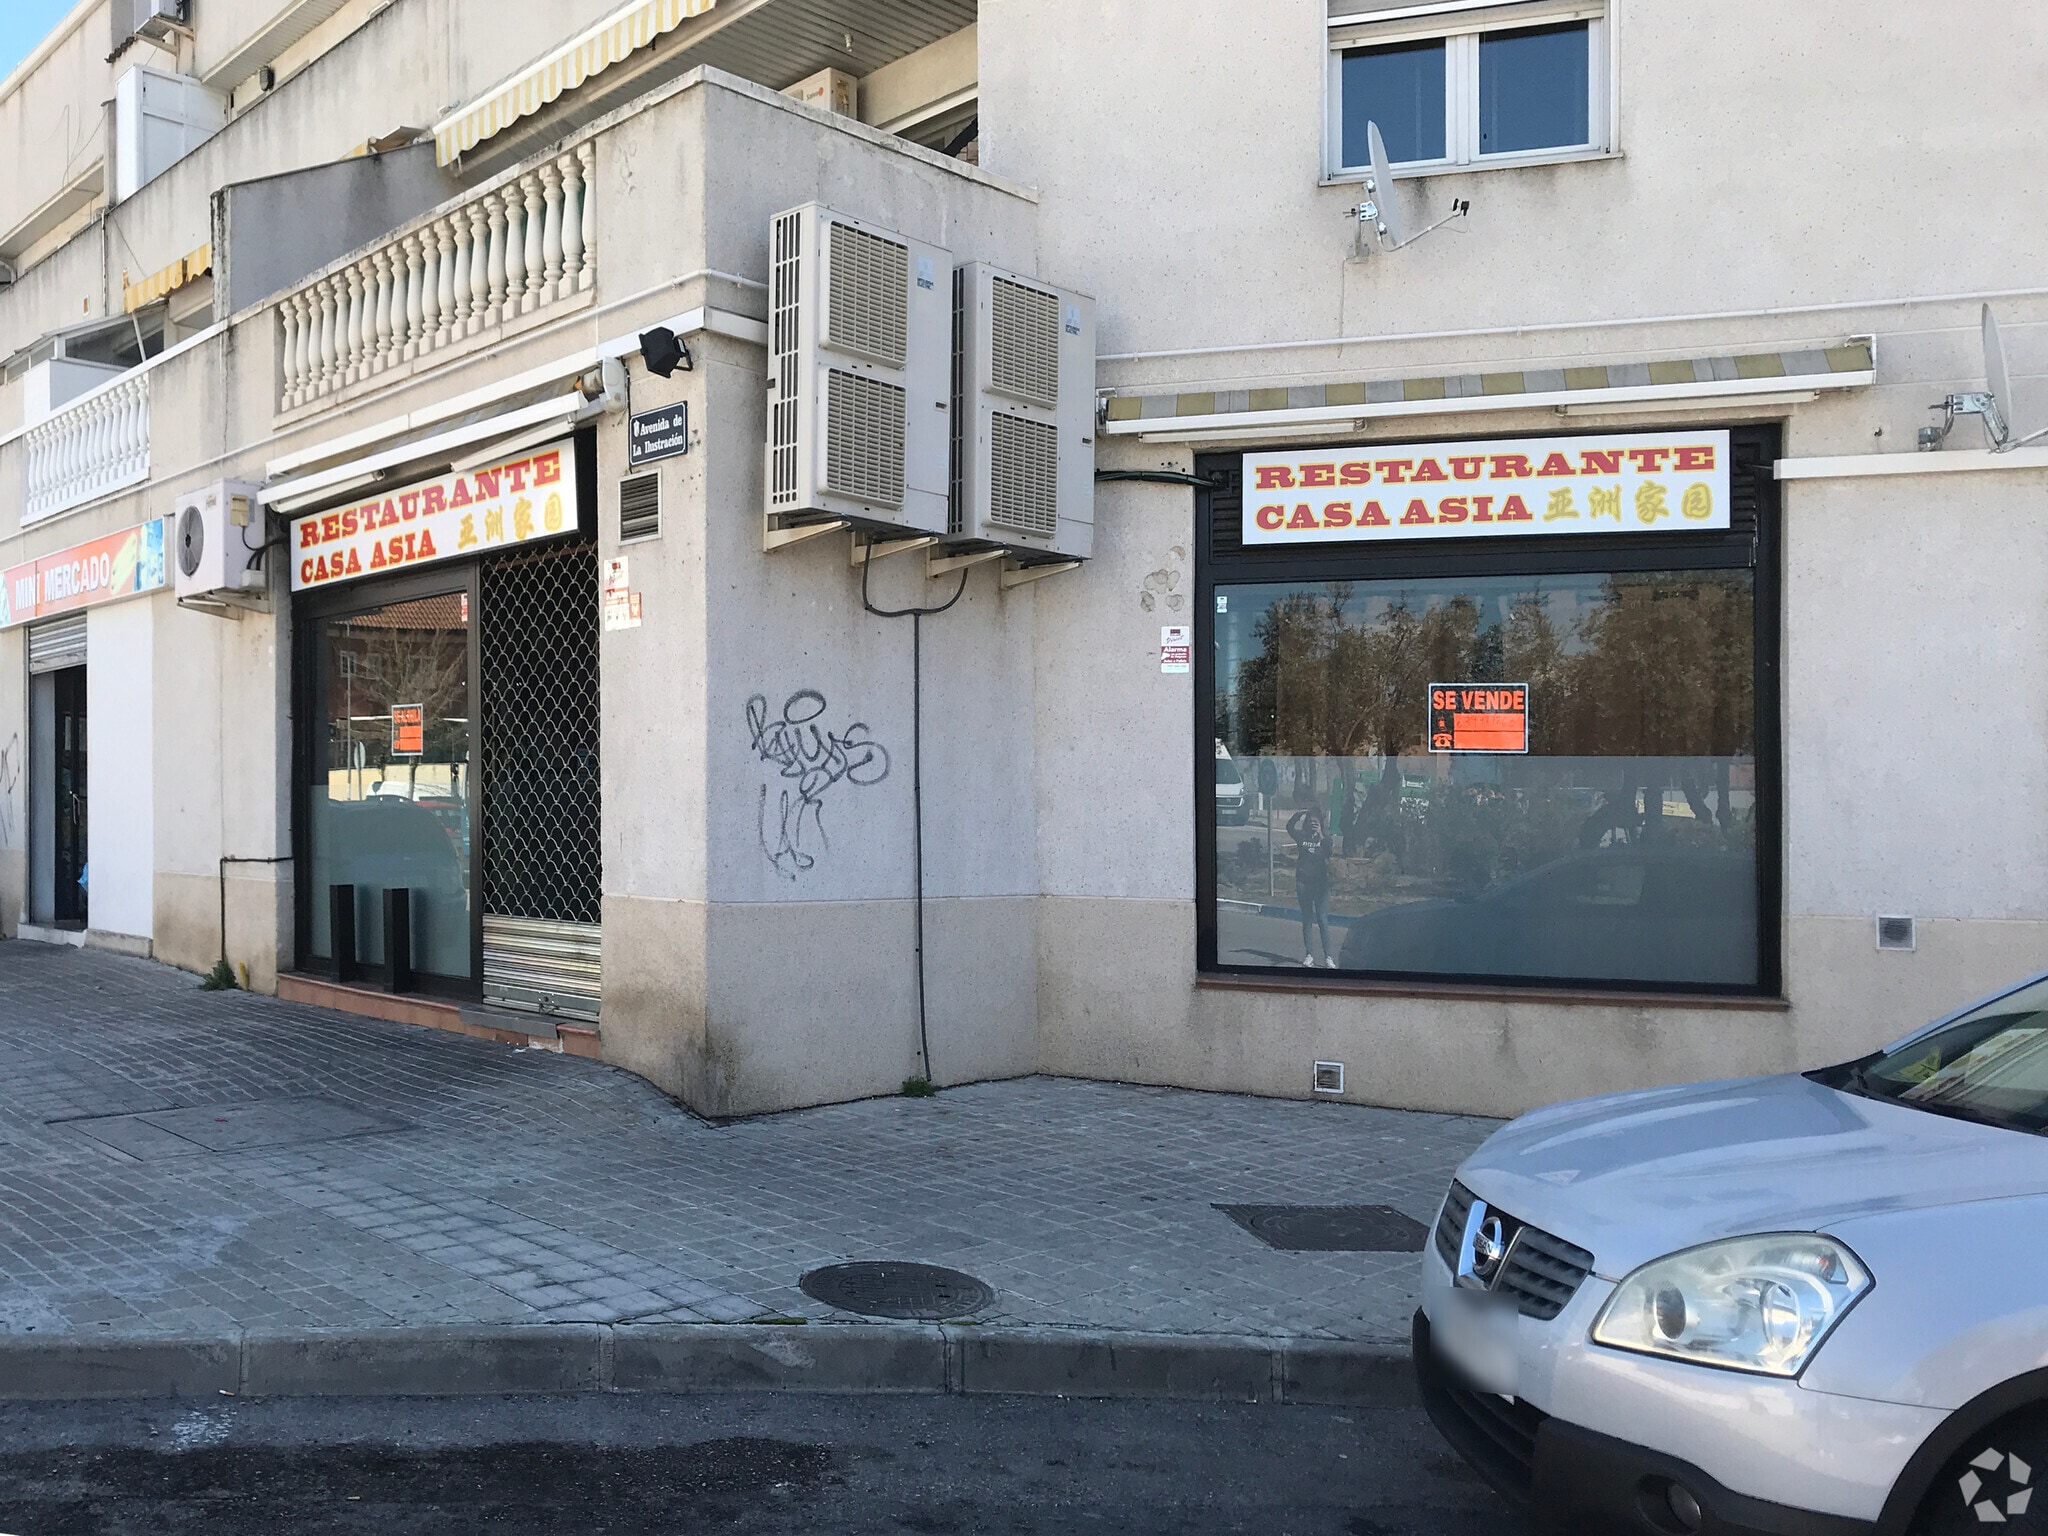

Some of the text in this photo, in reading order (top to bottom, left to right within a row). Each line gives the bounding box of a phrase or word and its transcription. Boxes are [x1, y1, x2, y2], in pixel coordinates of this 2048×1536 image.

[633, 432, 683, 457] La Ilustración
[640, 414, 683, 436] Avenida de
[1255, 446, 1715, 490] RESTAURANTE
[300, 450, 560, 548] RESTAURANTE
[1255, 494, 1534, 530] CASA ASIA
[1543, 480, 1714, 525] 亚洲家园
[300, 528, 437, 585] CASA ASIA
[15, 551, 110, 611] MINI MERCADO
[1433, 690, 1525, 710] SE VENDE
